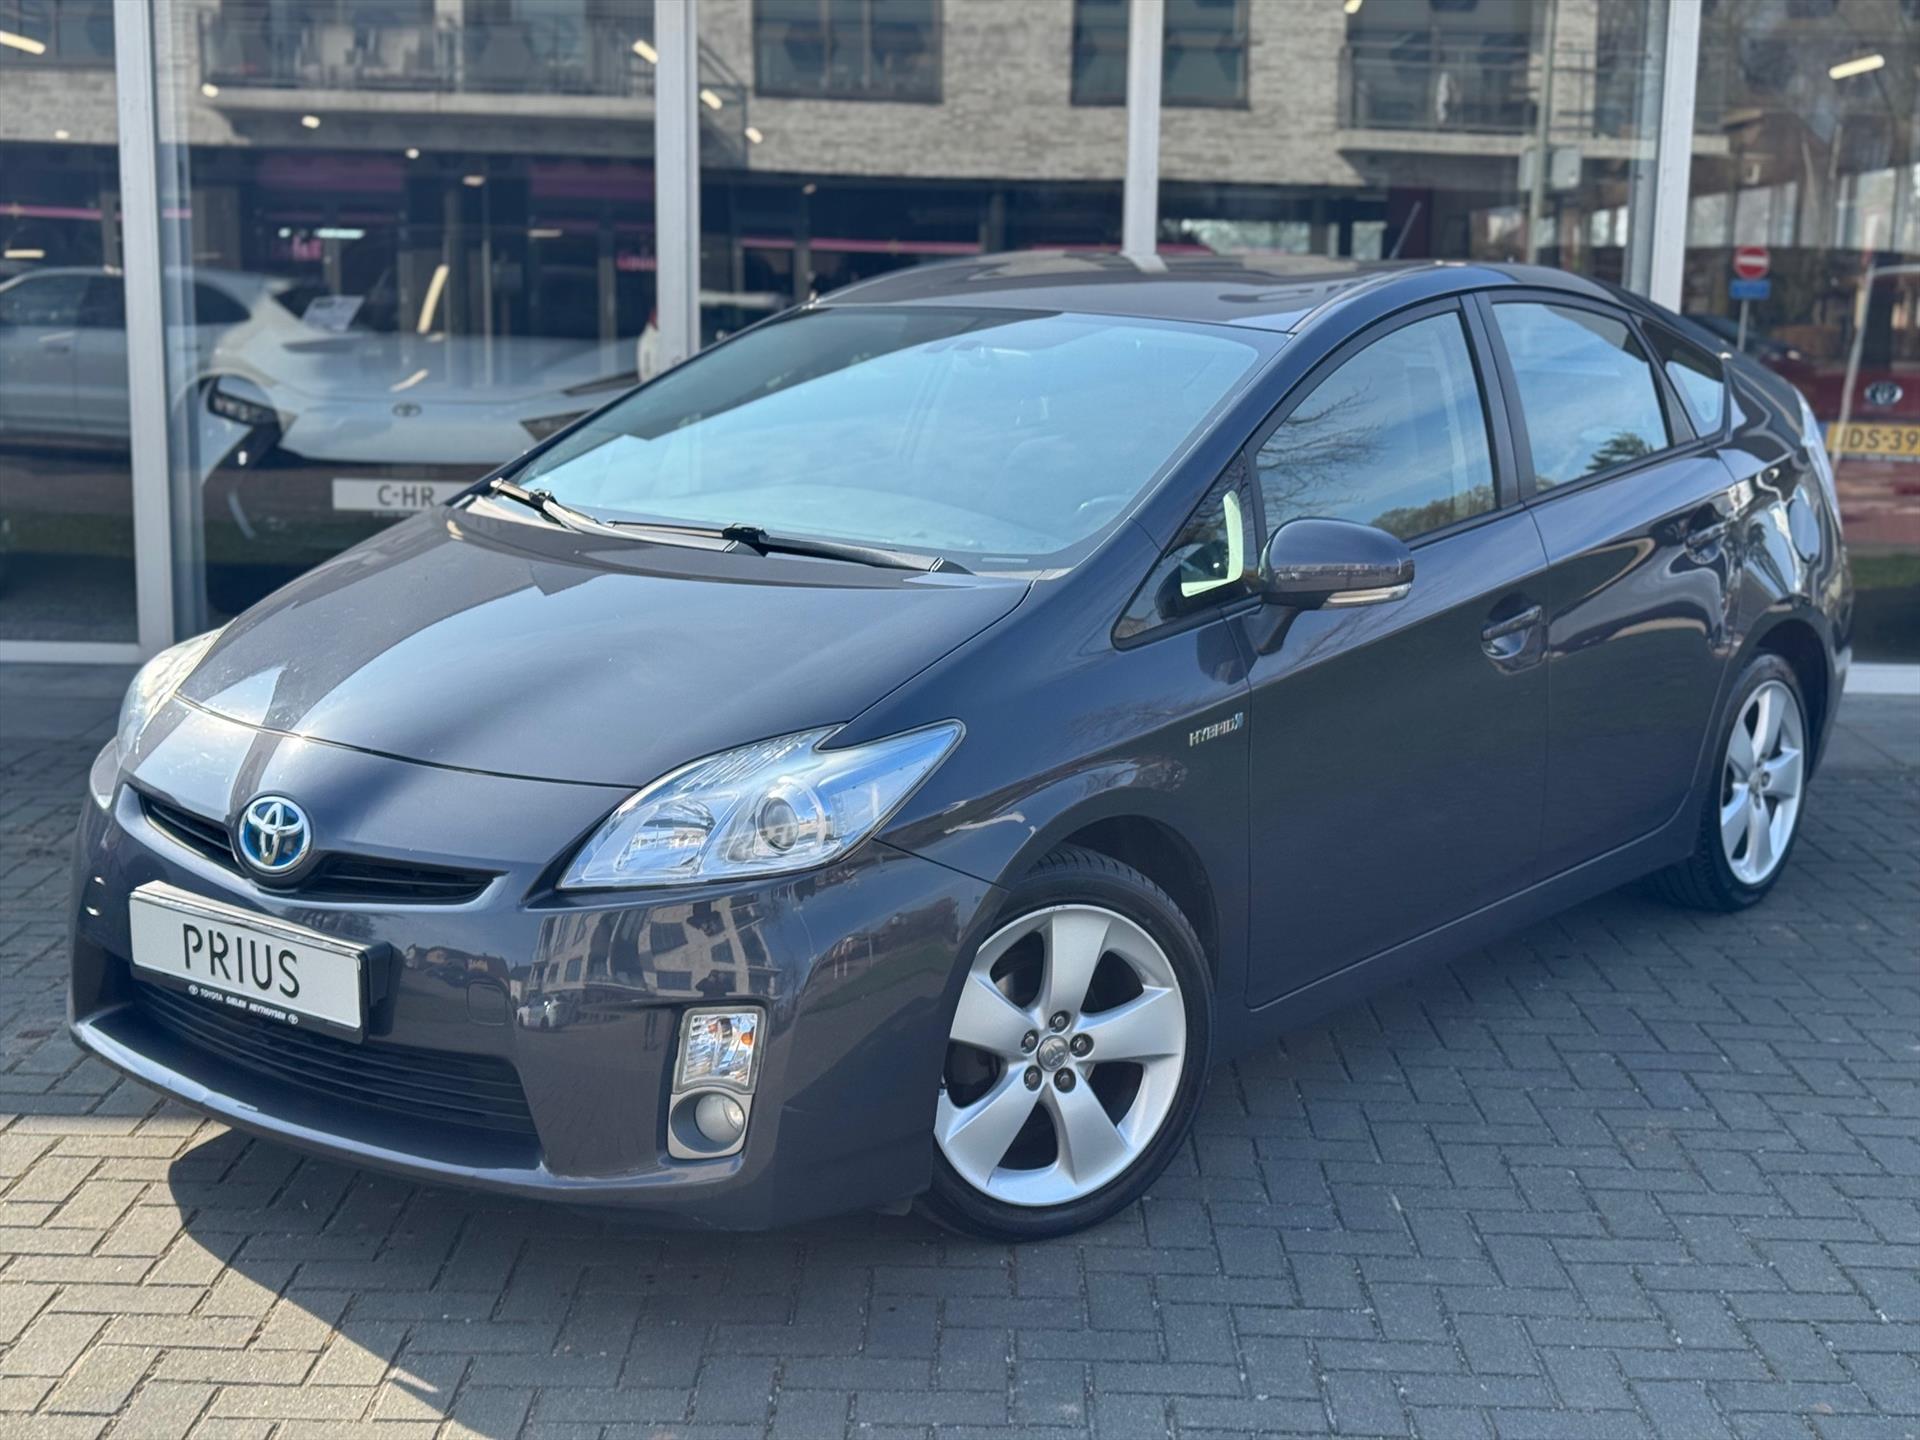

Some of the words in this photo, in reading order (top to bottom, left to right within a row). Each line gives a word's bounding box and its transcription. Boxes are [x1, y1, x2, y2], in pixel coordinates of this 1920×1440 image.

[377, 484, 435, 508] C-HR
[1188, 718, 1235, 747] HYBRID
[182, 923, 301, 999] PRIUS
[199, 987, 224, 1002] TOYOTA
